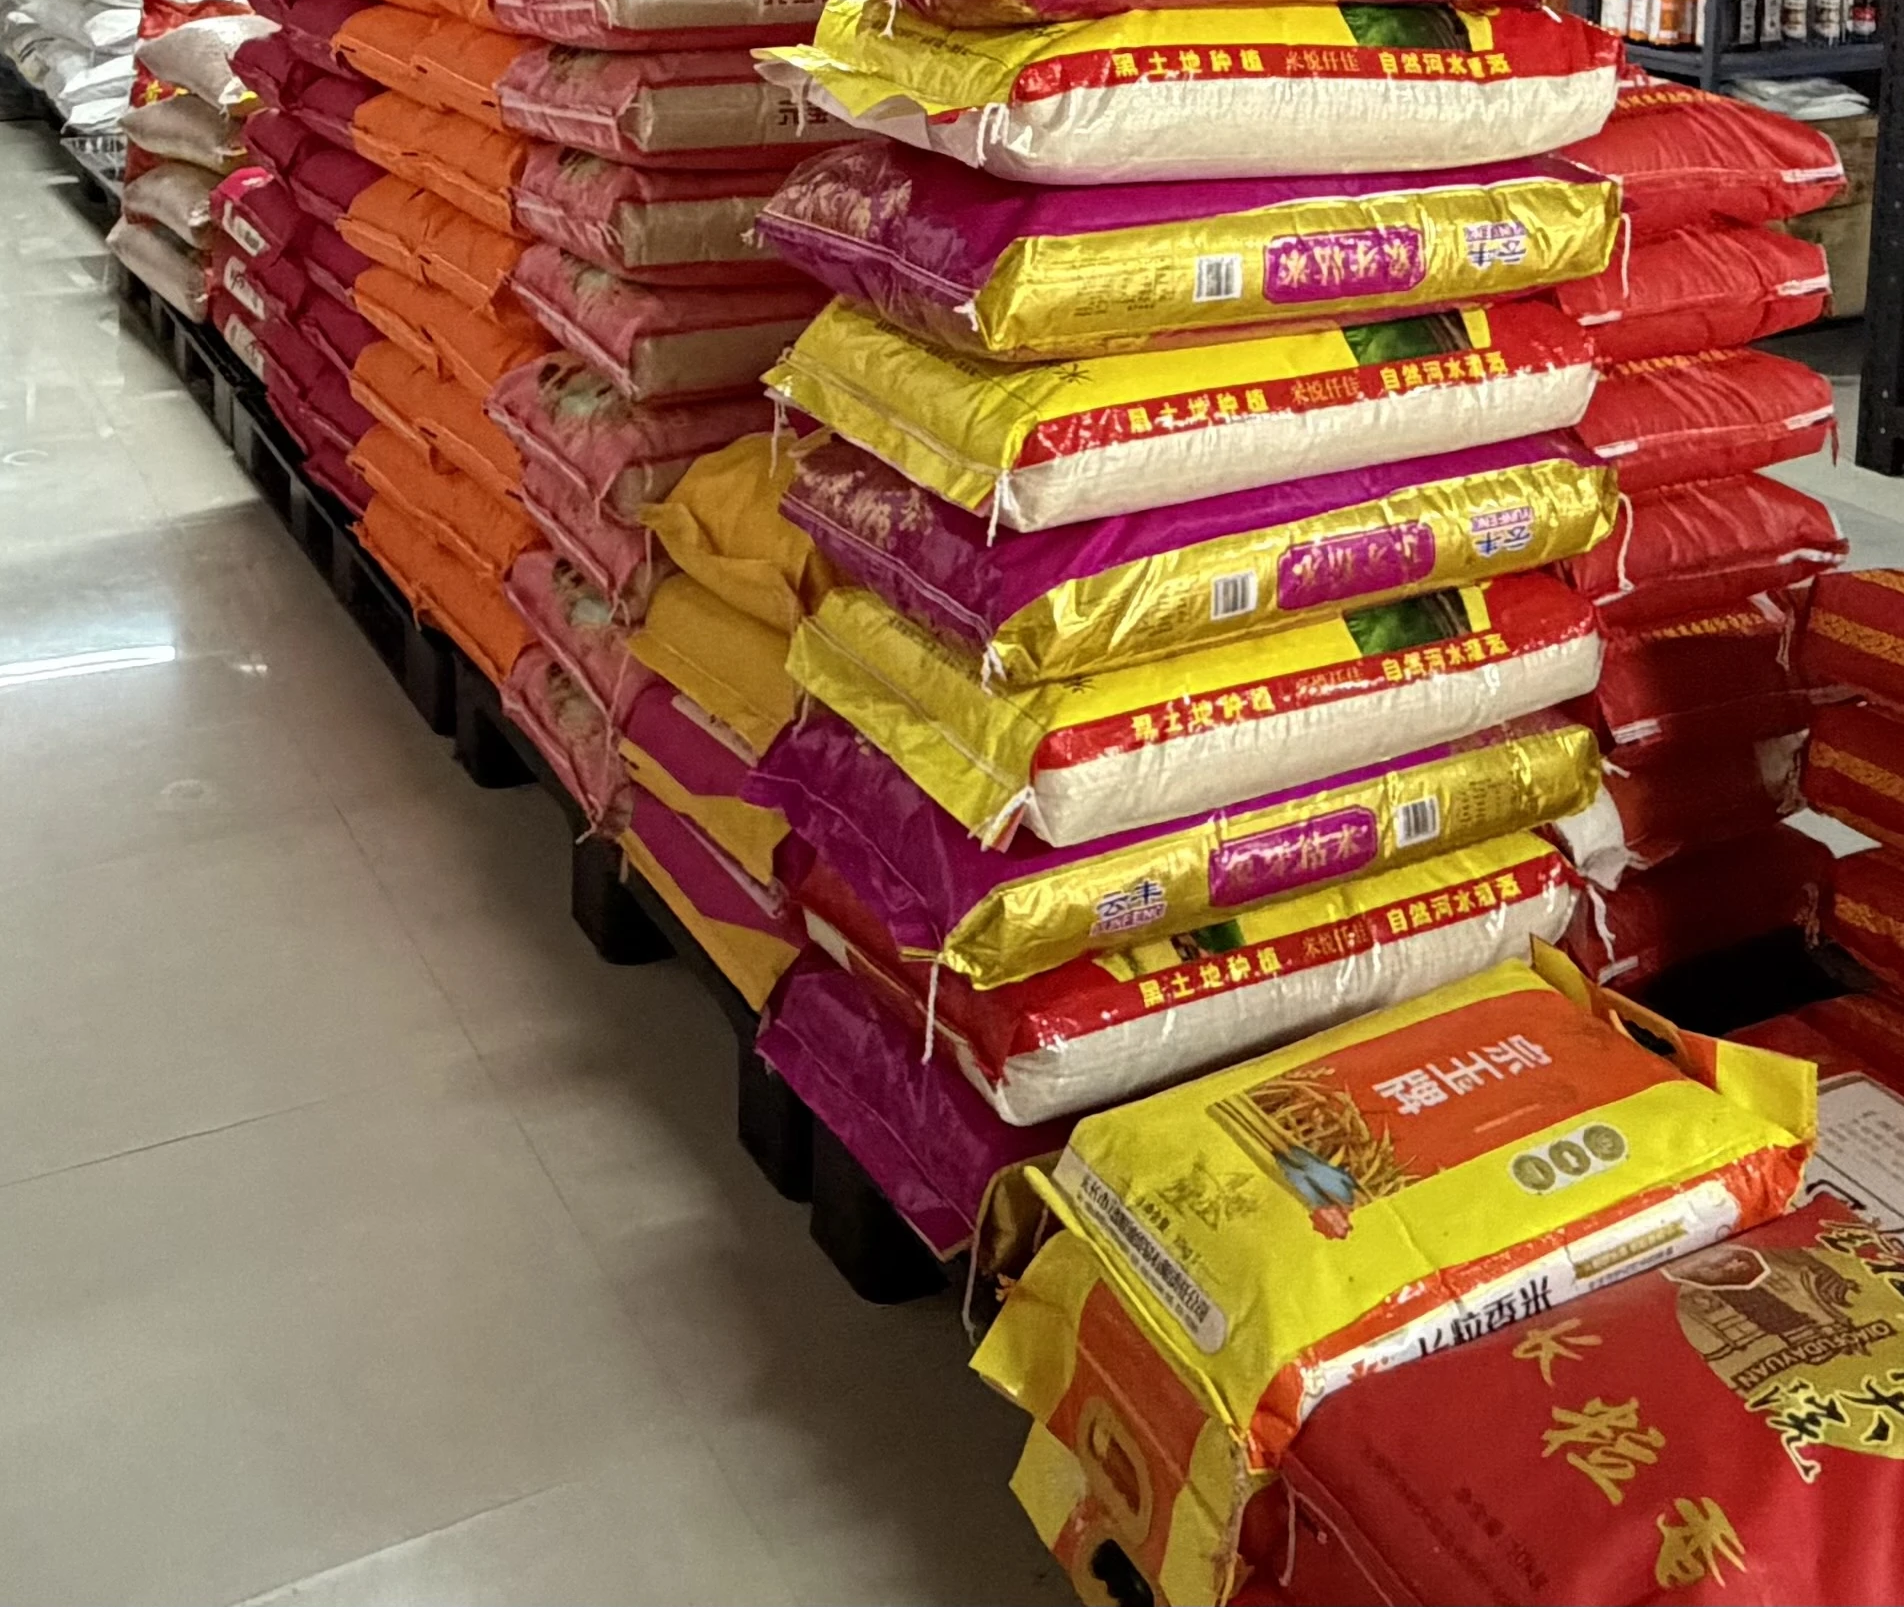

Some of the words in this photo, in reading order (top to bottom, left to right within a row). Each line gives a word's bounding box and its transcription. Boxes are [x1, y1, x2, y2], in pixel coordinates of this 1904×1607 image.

[1112, 49, 1265, 79] 黑土地种植
[1099, 878, 1165, 921] 云丰
[1140, 946, 1283, 1009] 黑土地种植
